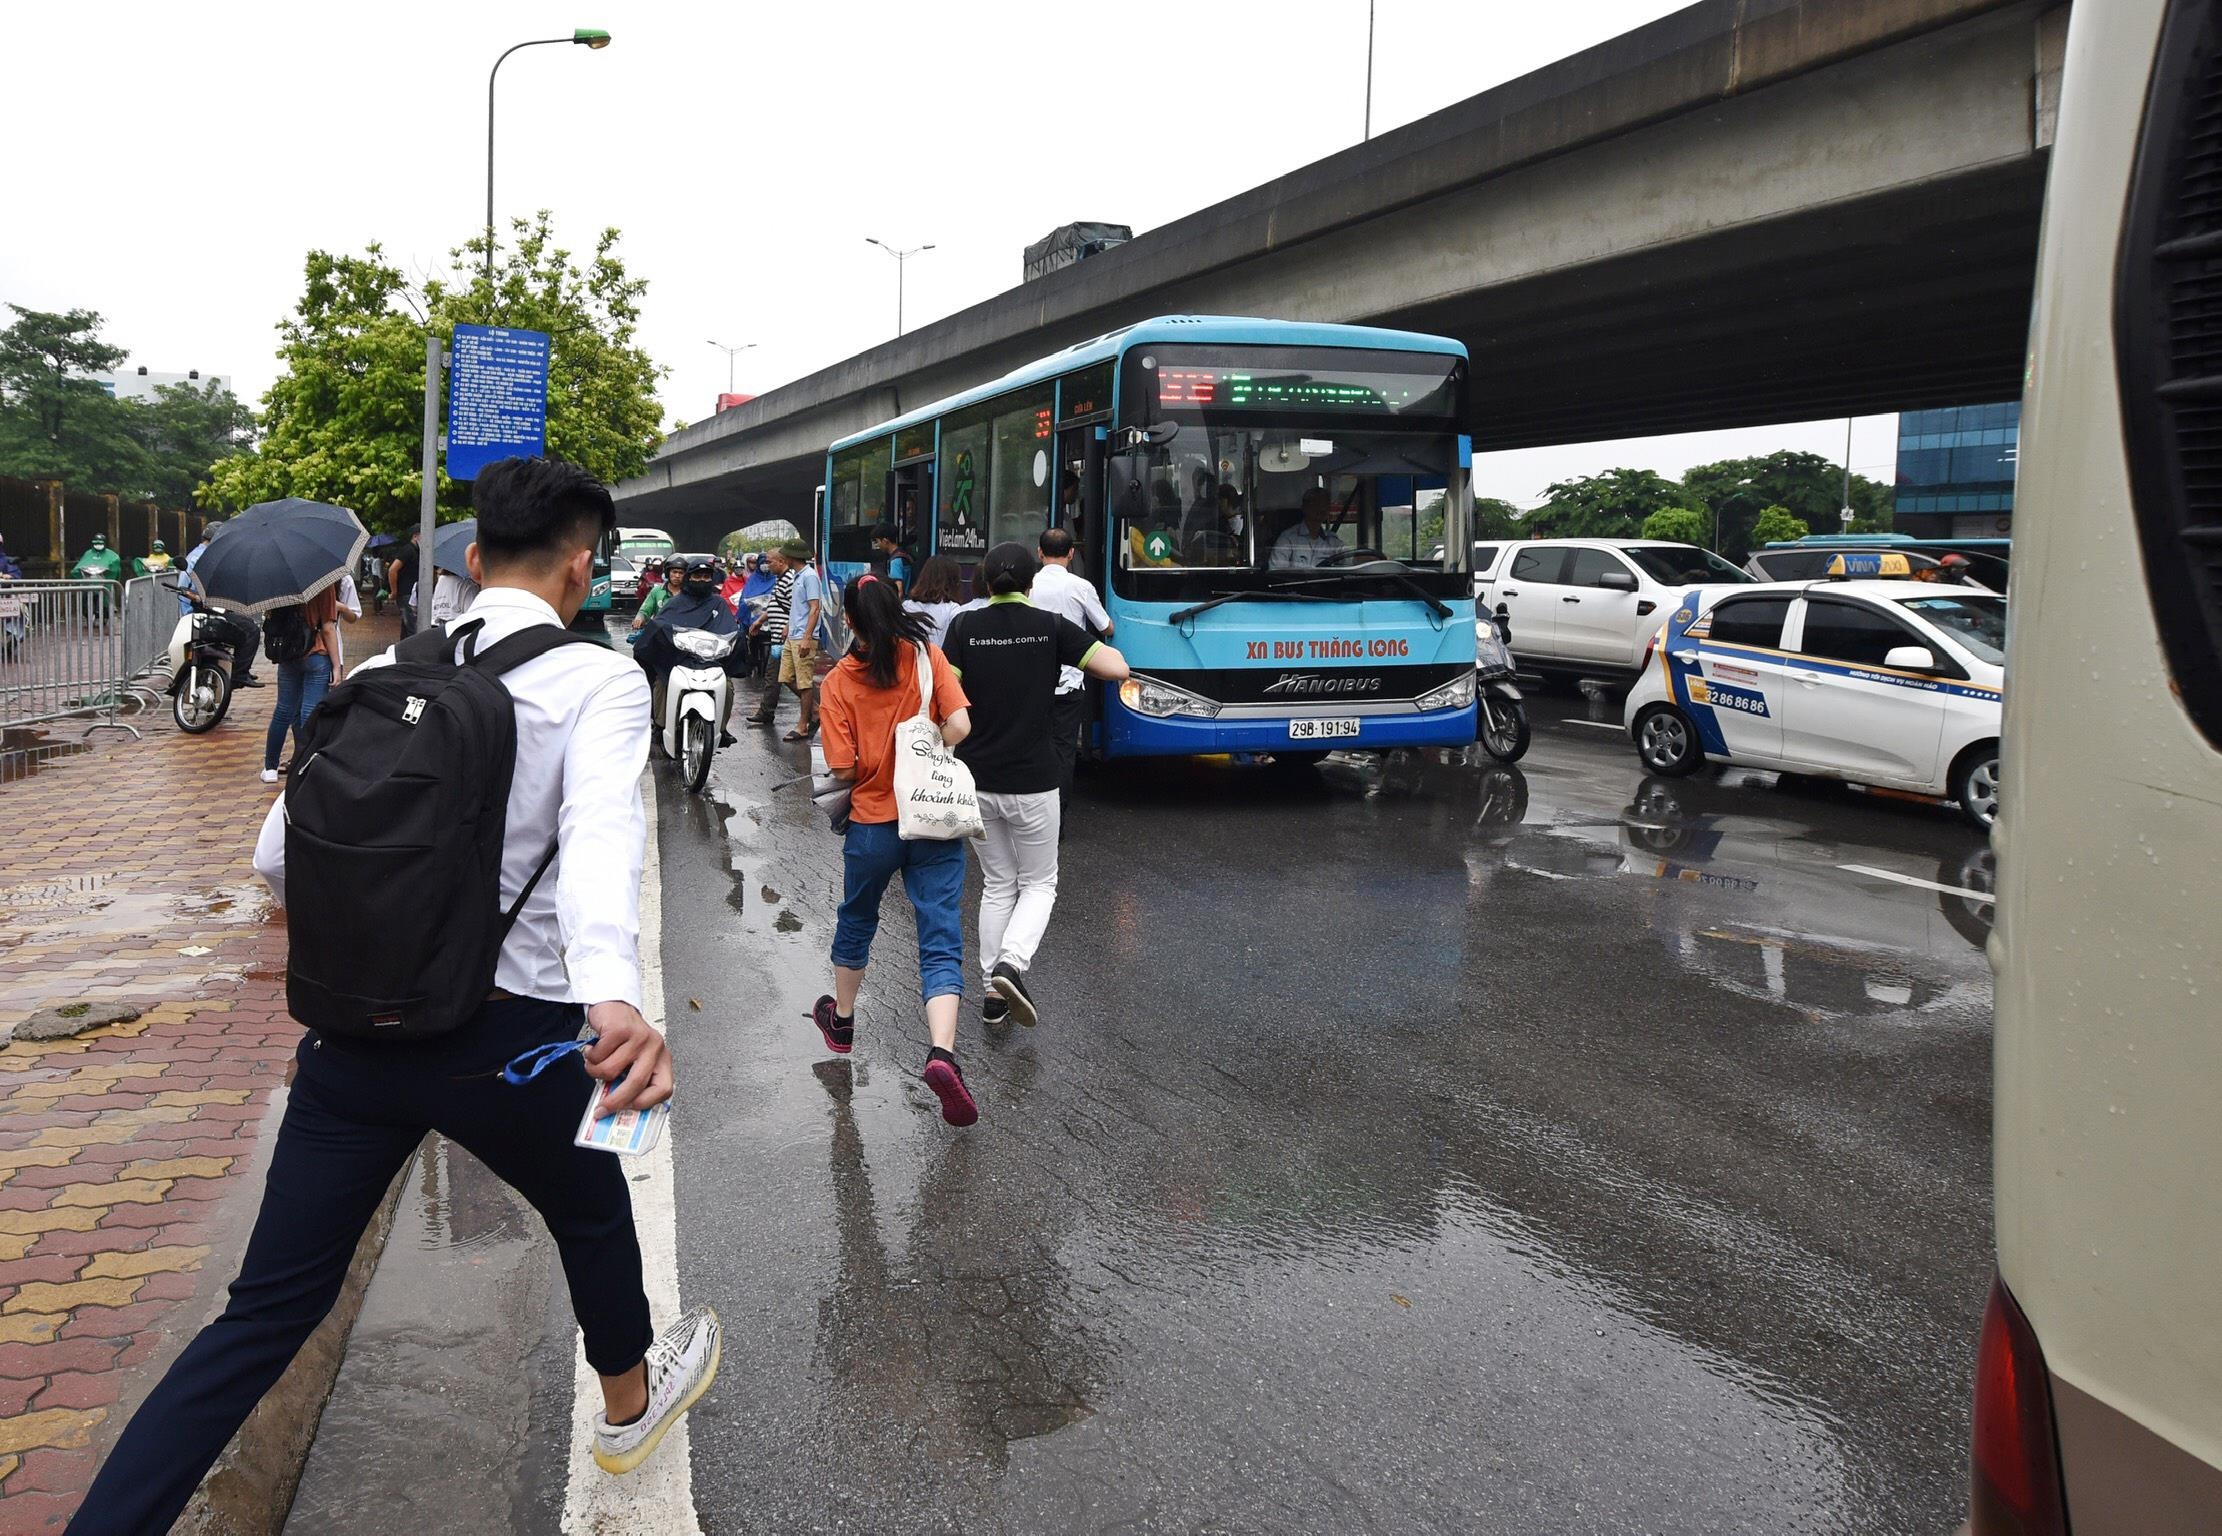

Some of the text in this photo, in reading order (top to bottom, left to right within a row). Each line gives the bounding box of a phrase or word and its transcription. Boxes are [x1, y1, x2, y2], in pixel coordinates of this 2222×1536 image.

[969, 635, 1049, 646] Evashoes.com.vn
[1273, 640, 1304, 659] BUS
[1308, 636, 1364, 658] THĂNG
[1367, 638, 1409, 658] LONG
[1264, 673, 1382, 694] HANOIBUS
[1704, 690, 1719, 703] 32
[1720, 692, 1733, 706] 86
[1734, 696, 1748, 709] 86
[1750, 699, 1765, 713] 86
[910, 787, 955, 805] khoảnh
